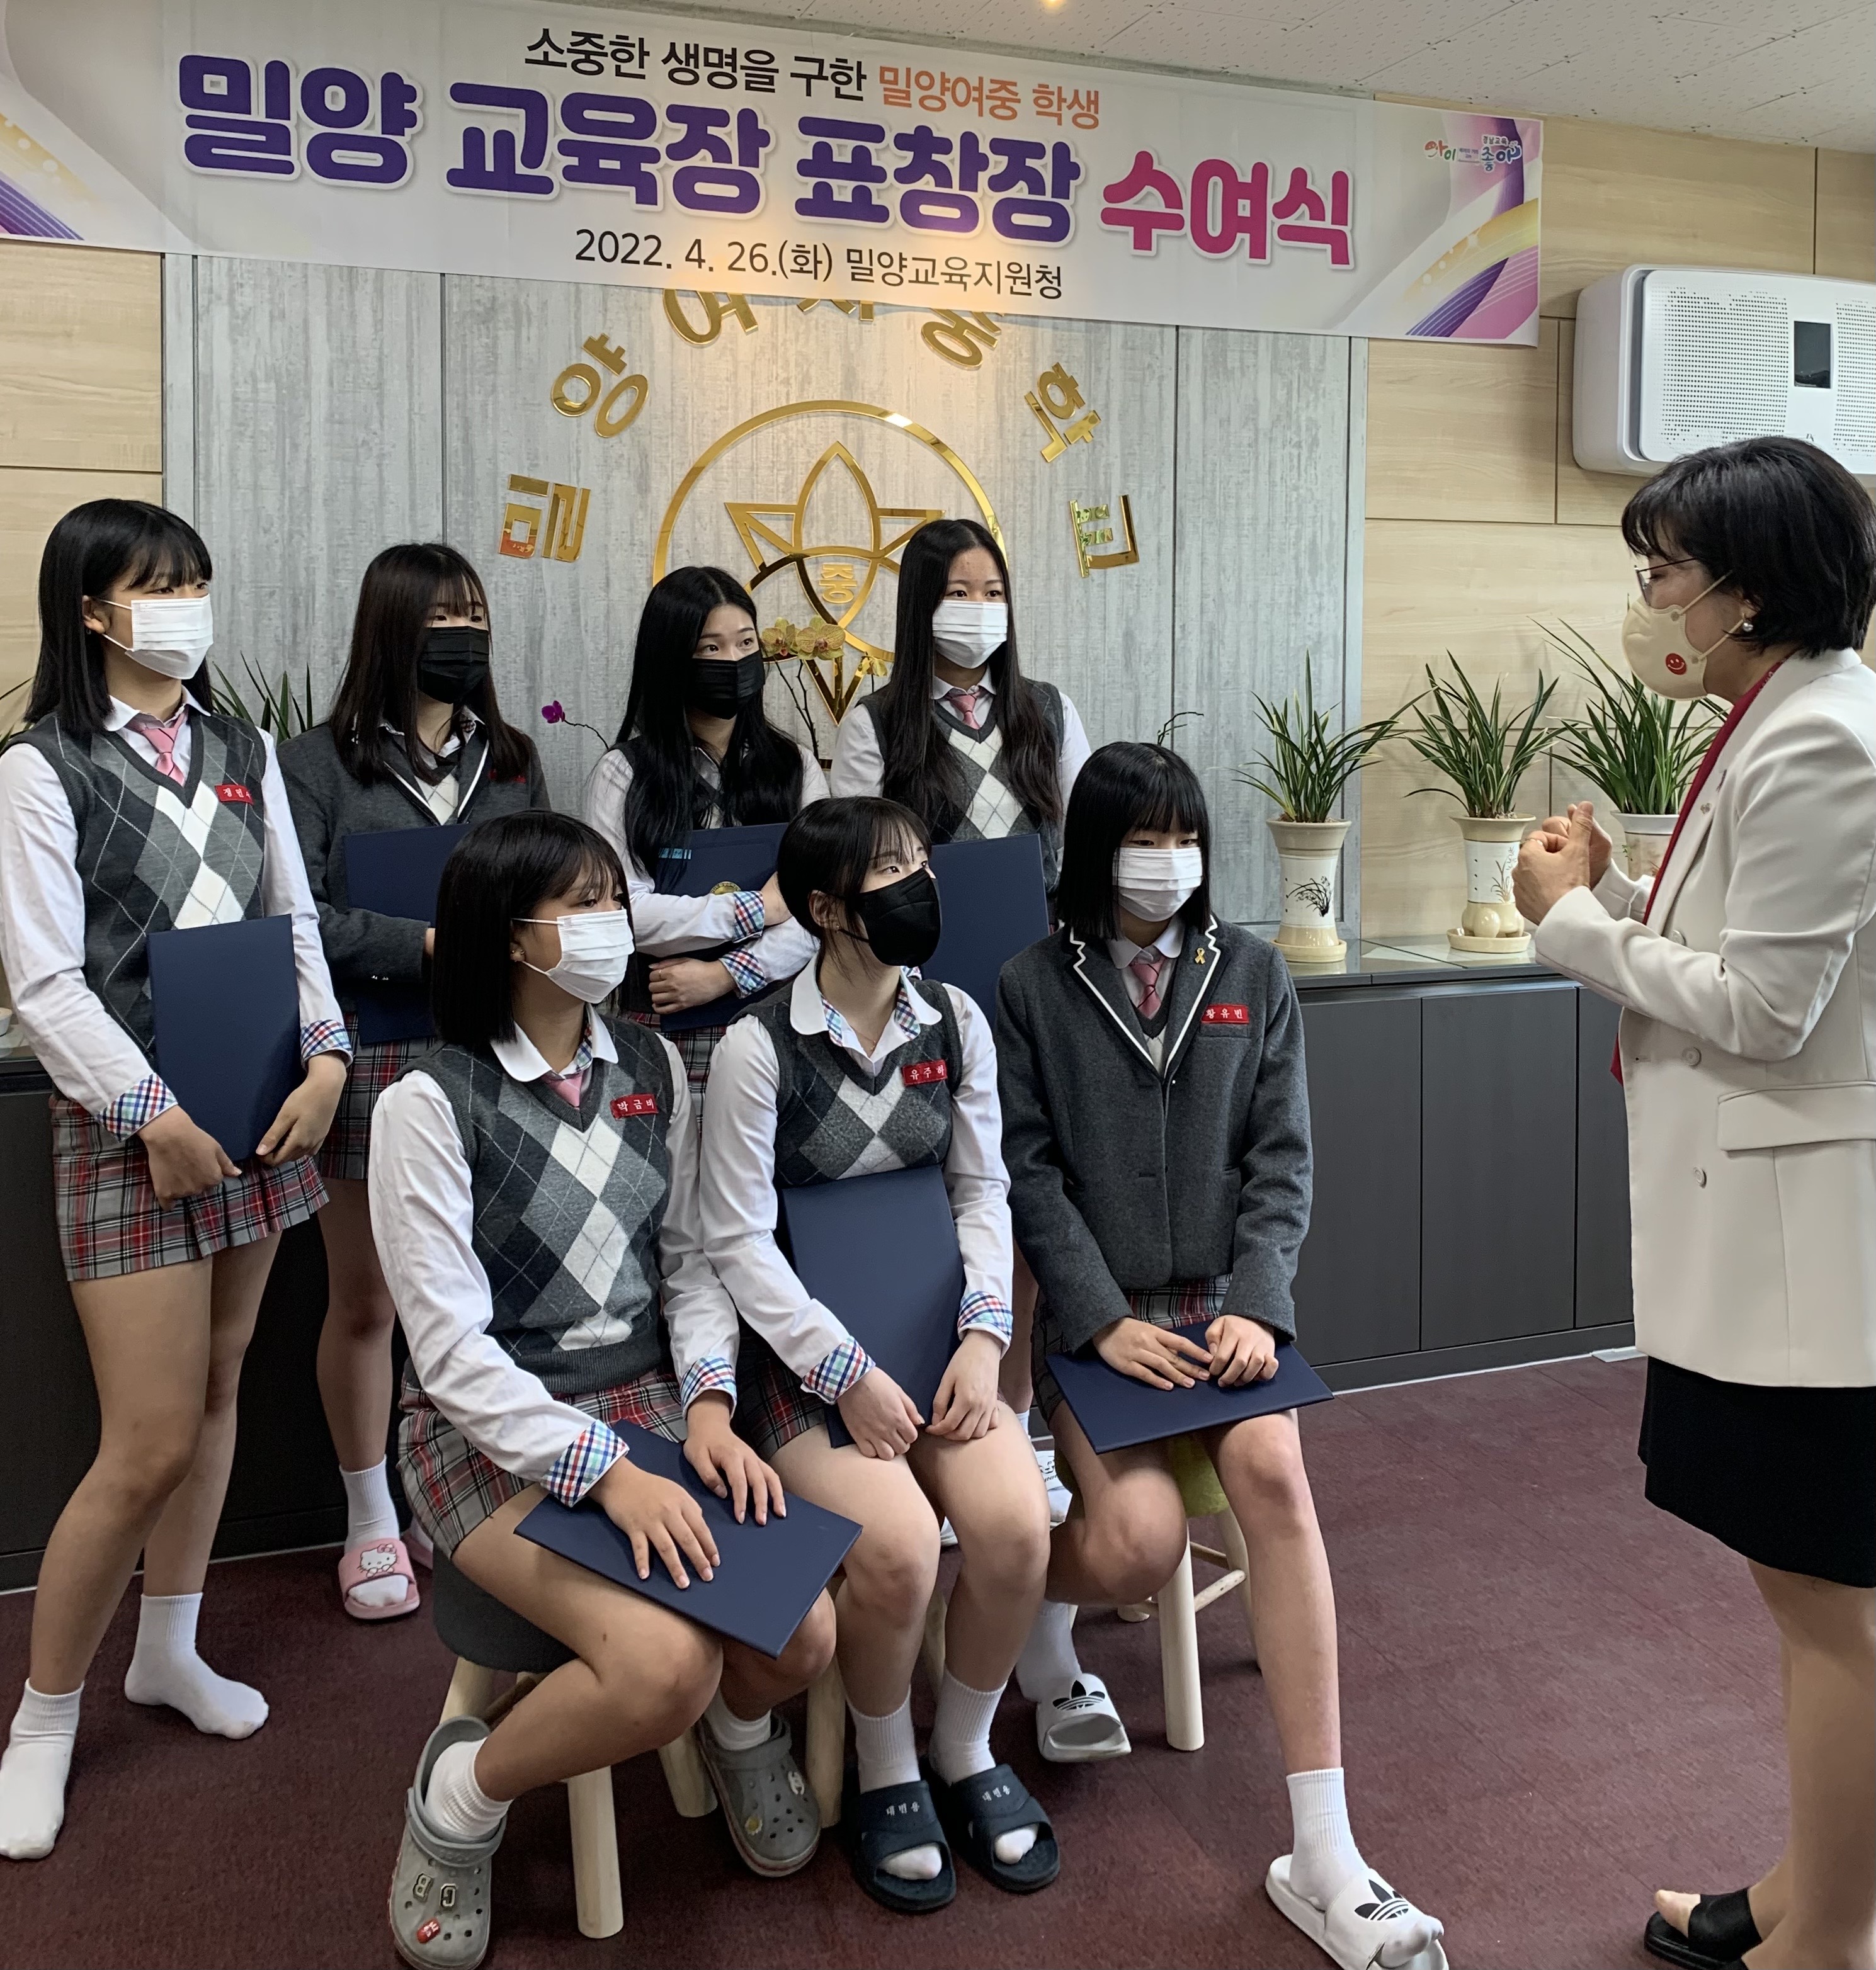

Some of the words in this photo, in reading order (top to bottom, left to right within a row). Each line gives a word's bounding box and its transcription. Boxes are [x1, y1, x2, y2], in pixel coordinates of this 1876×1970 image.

[525, 28, 650, 79] 소중한
[661, 42, 779, 93] 생명을
[790, 55, 867, 101] 구한
[879, 65, 1021, 121] 밀양여중
[1032, 83, 1100, 130] 학생
[1424, 140, 1456, 161] 아이
[1481, 144, 1521, 172] 좋아
[1483, 135, 1508, 145] 경남교육
[179, 54, 418, 183] 밀양
[445, 82, 771, 214] 교육장
[795, 116, 1081, 242] 표창장
[1101, 151, 1351, 265] 수여식
[575, 229, 672, 269] 2022.
[685, 239, 714, 272] 4.
[727, 240, 833, 282] 26.(화)
[846, 248, 1062, 300] 밀양교육지원청
[819, 563, 857, 604] 중
[1205, 1007, 1243, 1019] 황유빈
[617, 1097, 654, 1112] 박금비
[413, 1873, 433, 1900] B
